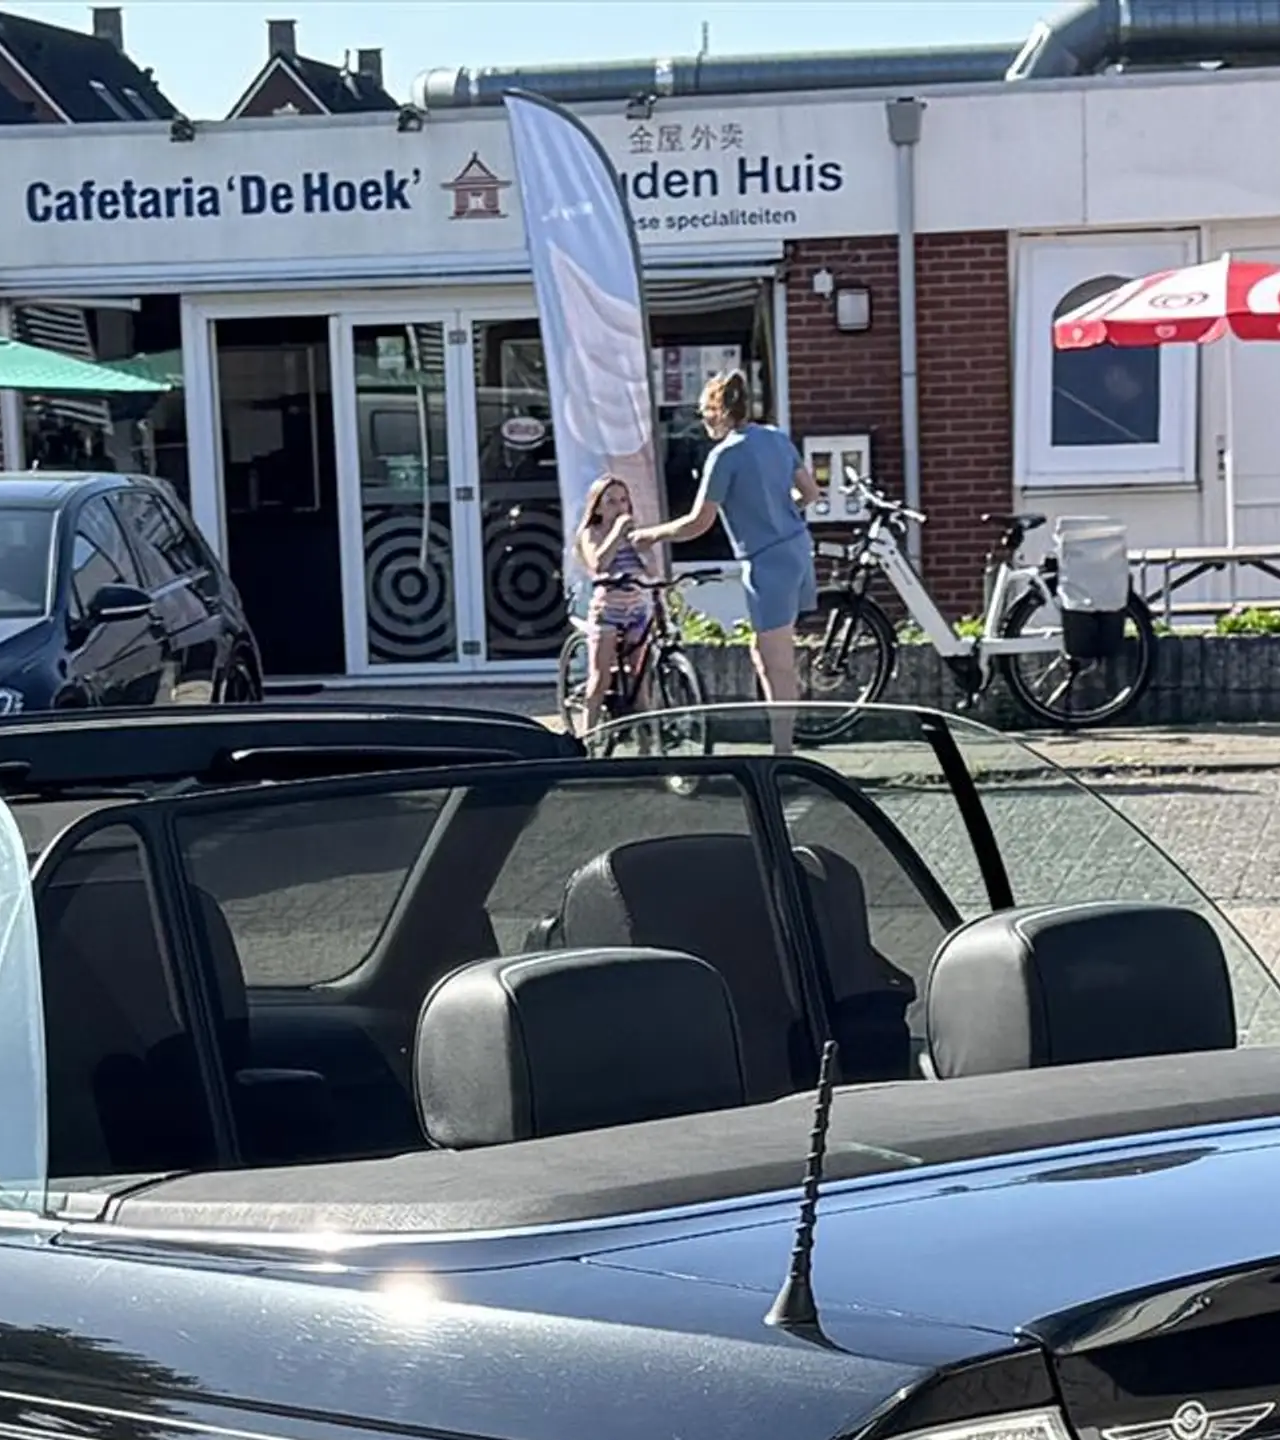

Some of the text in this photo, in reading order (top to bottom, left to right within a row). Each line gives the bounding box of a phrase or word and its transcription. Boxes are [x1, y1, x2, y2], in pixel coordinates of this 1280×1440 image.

[737, 153, 843, 195] Huis
[25, 176, 221, 223] Cafetaria
[303, 168, 422, 212] Hoek'
[665, 207, 798, 230] specialiteiten
